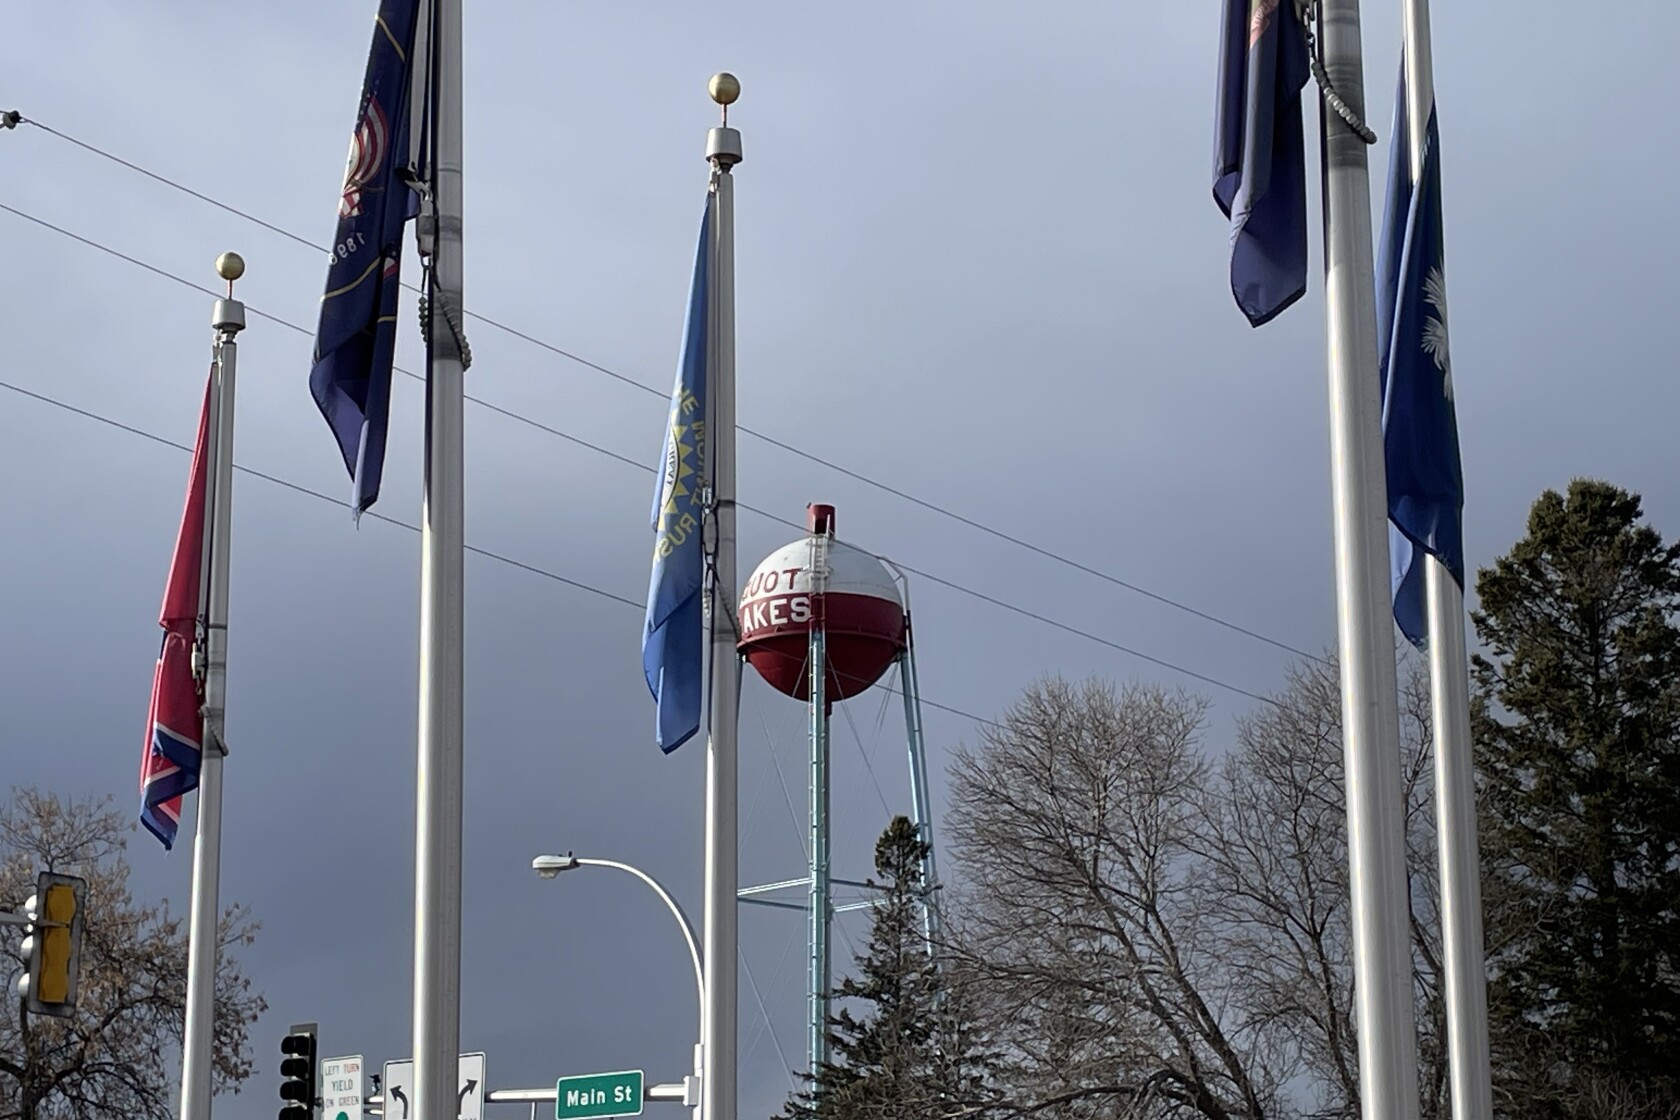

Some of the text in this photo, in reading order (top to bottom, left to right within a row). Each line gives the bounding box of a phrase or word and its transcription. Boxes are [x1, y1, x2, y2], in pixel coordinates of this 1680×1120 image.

[325, 1065, 339, 1076] LEFT
[332, 1079, 353, 1091] YIELD
[339, 1096, 359, 1106] GREEN
[567, 1085, 632, 1108] Main St
